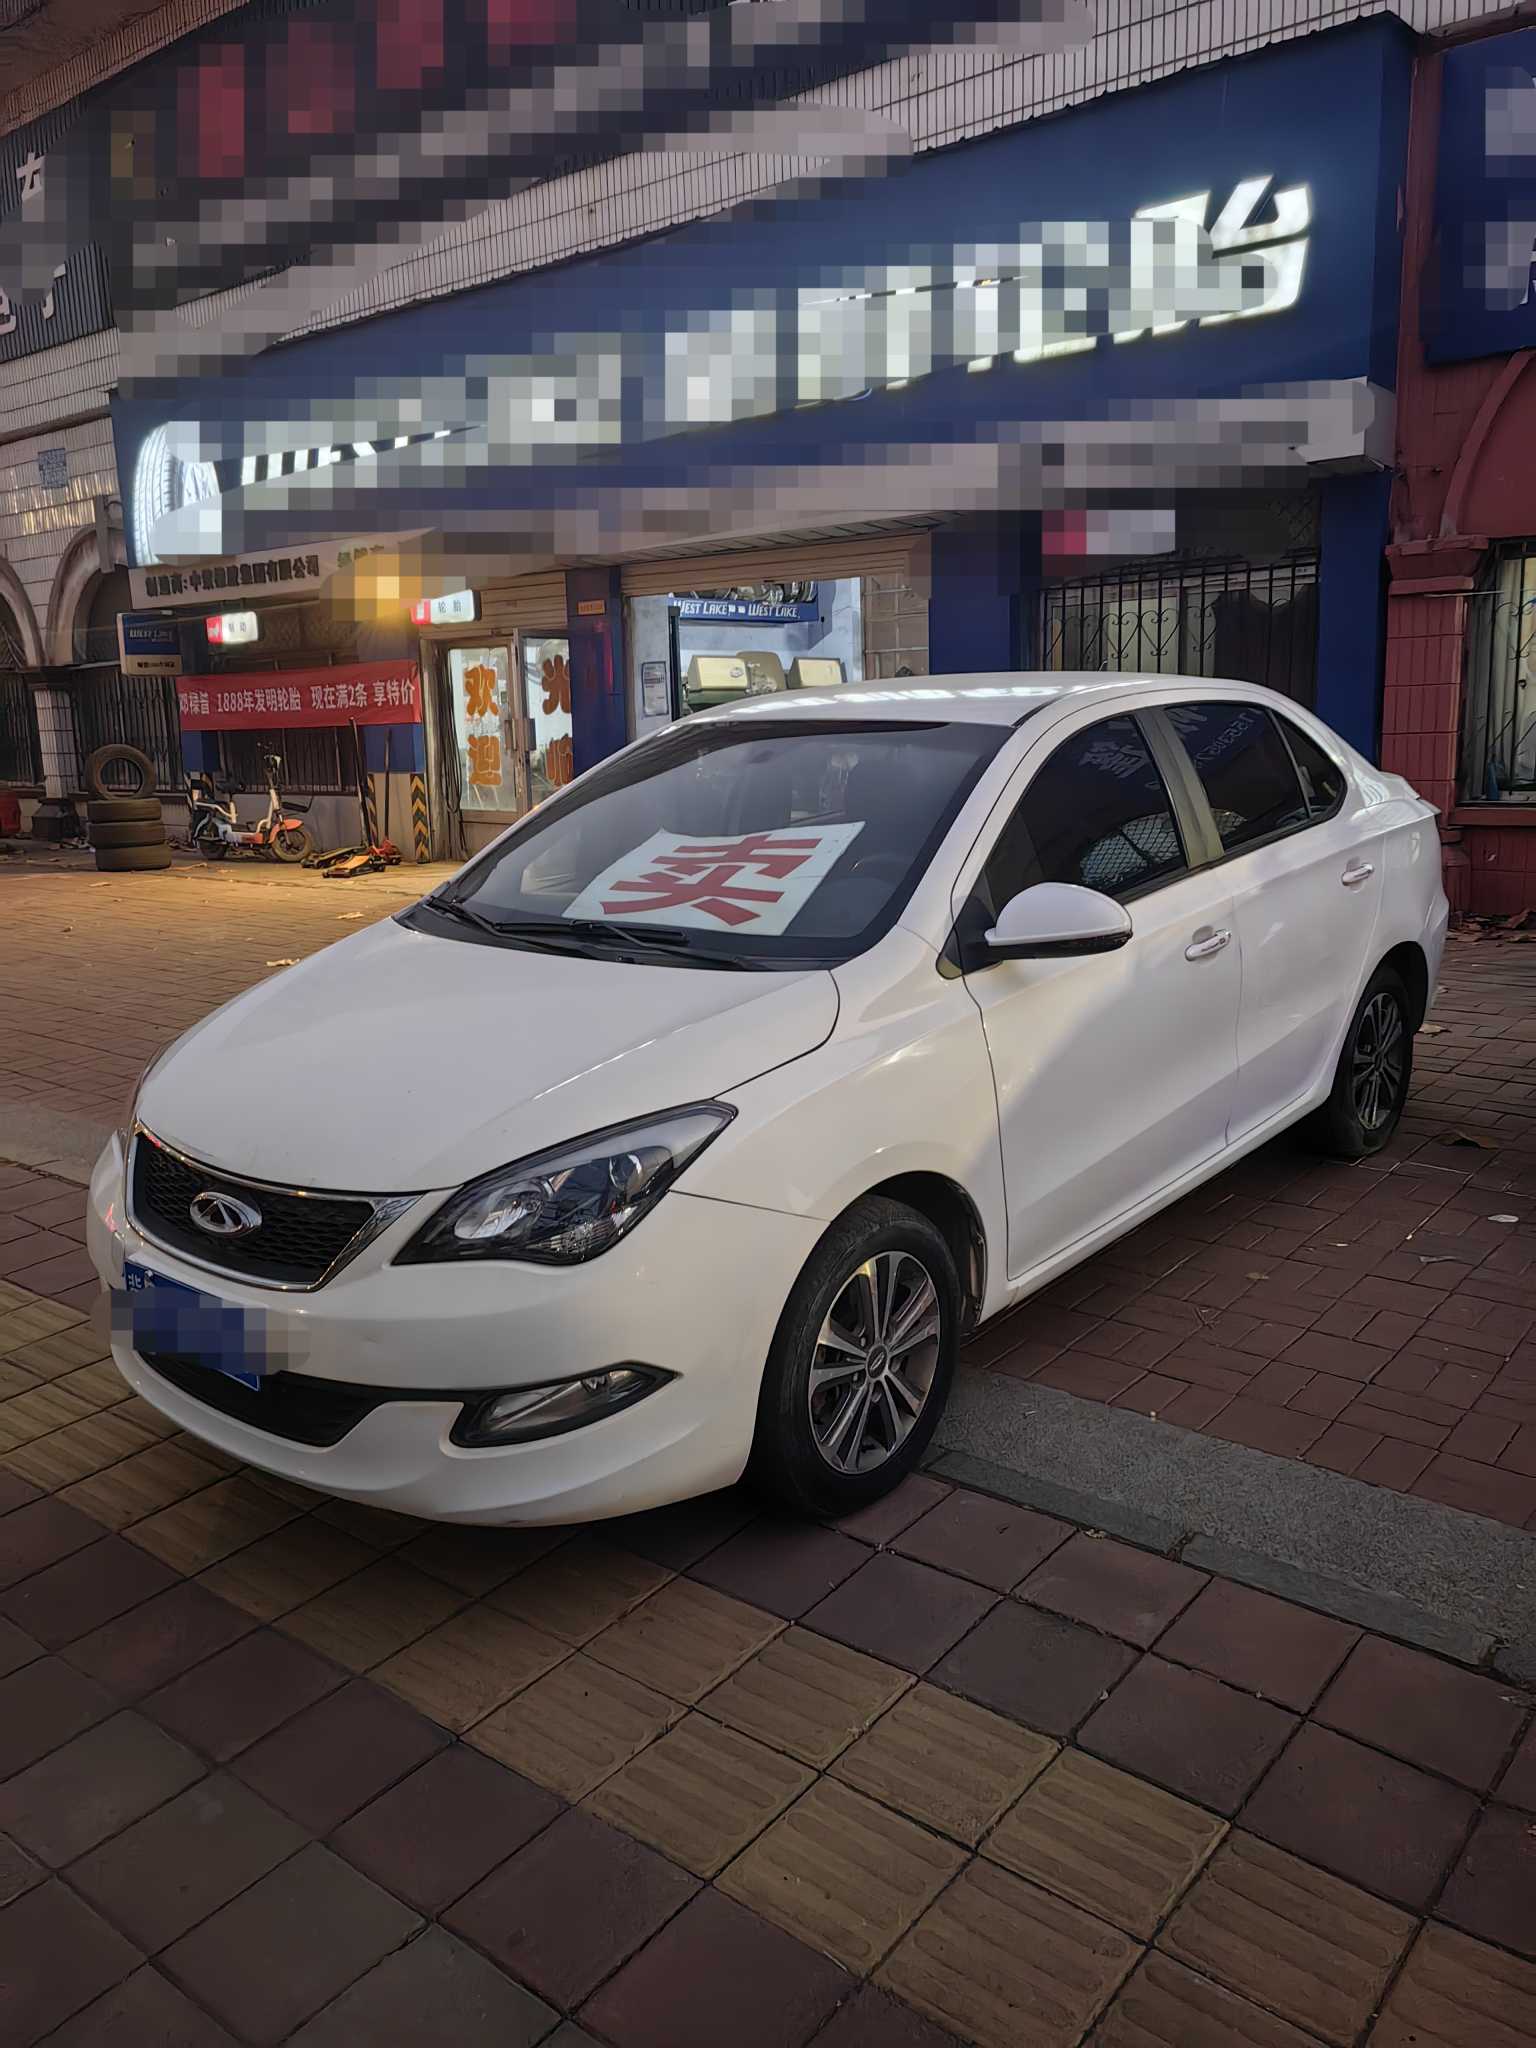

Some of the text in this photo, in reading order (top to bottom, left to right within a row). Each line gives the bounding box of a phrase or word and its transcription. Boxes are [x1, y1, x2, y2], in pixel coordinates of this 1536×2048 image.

[703, 600, 729, 616] LAKE
[748, 604, 774, 617] WEST
[775, 604, 799, 618] LAKE
[217, 687, 301, 714] 1888年发明轮胎
[310, 683, 368, 710] 现在满2条
[373, 678, 416, 707] 享特价
[464, 664, 502, 786] 欢迎
[600, 833, 823, 928] 卖
